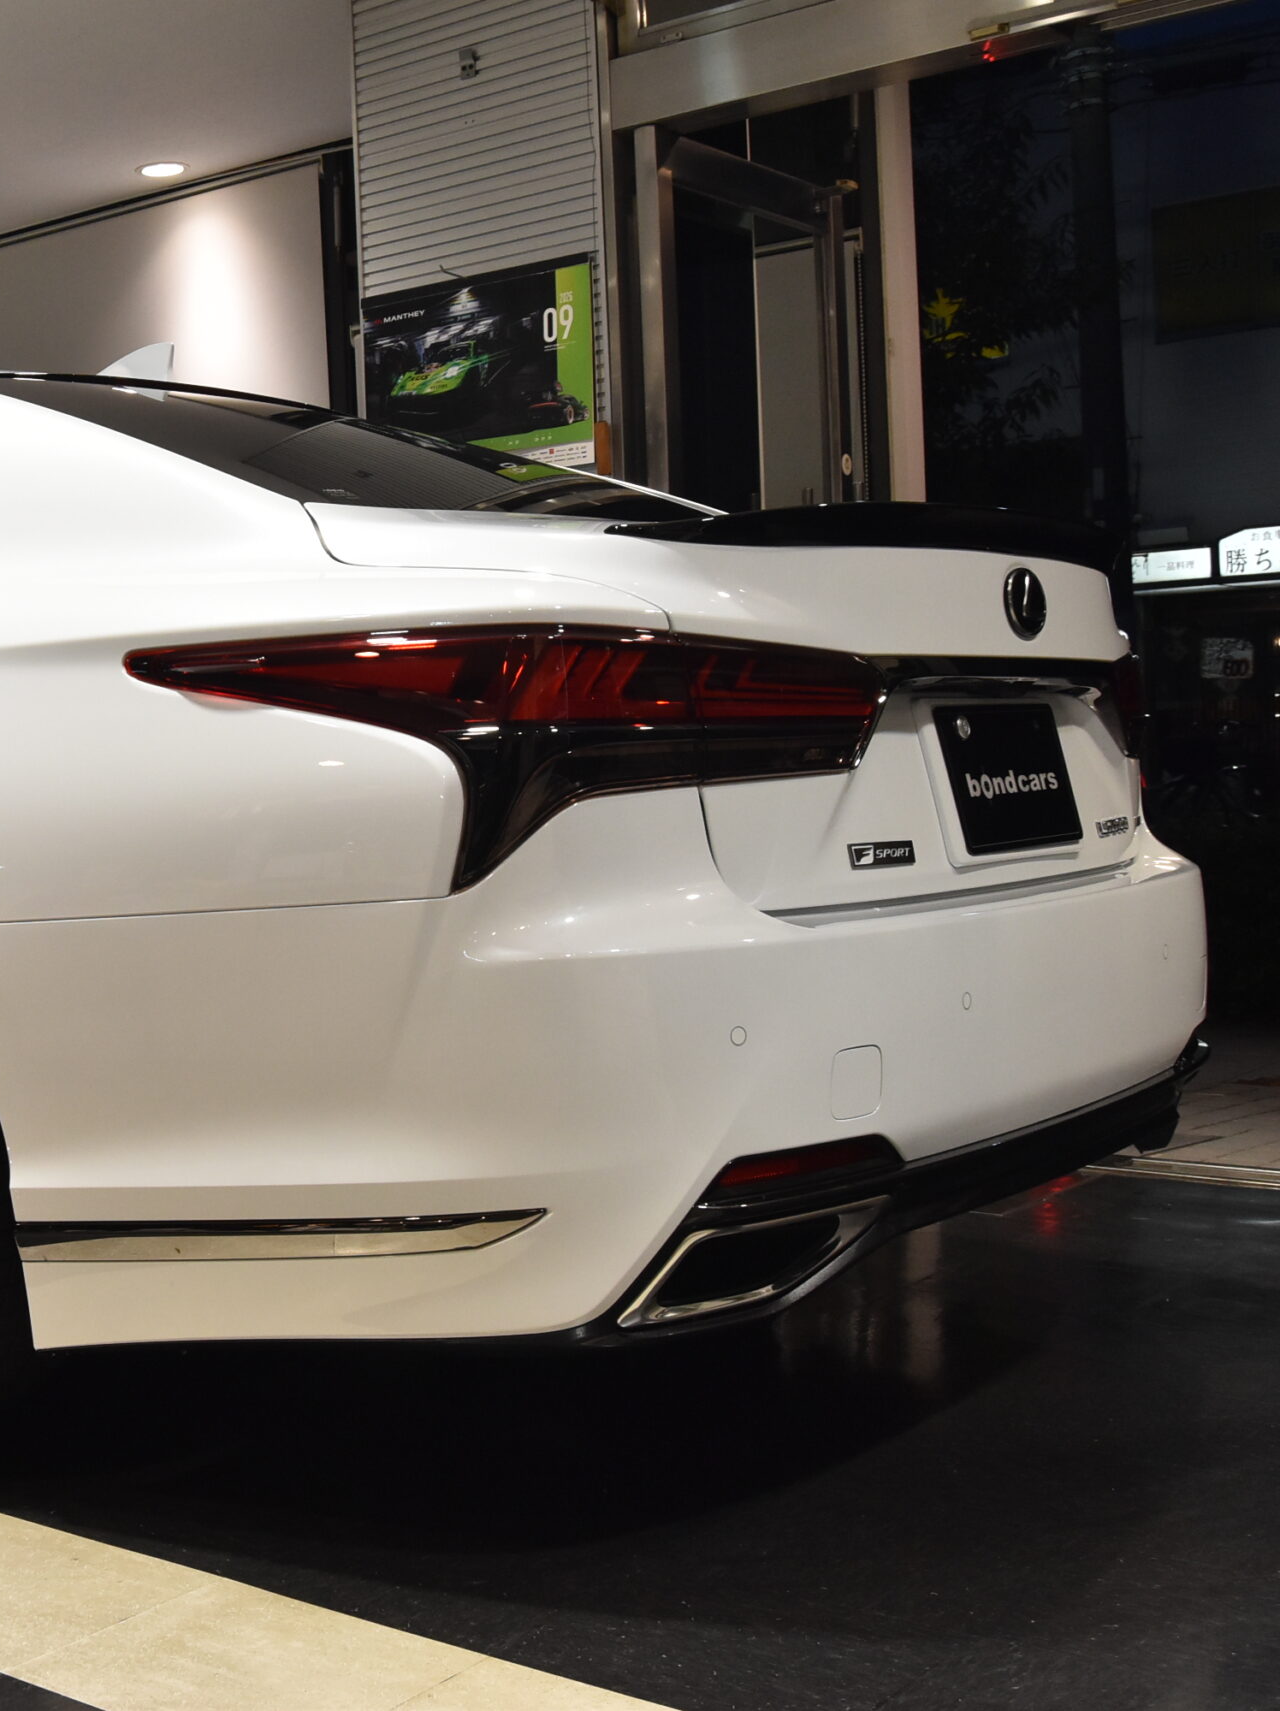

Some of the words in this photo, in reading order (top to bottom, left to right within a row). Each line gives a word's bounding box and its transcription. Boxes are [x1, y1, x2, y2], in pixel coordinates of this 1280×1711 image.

[383, 310, 425, 324] MANTHEY
[543, 305, 574, 343] 09
[876, 847, 911, 859] SPORT
